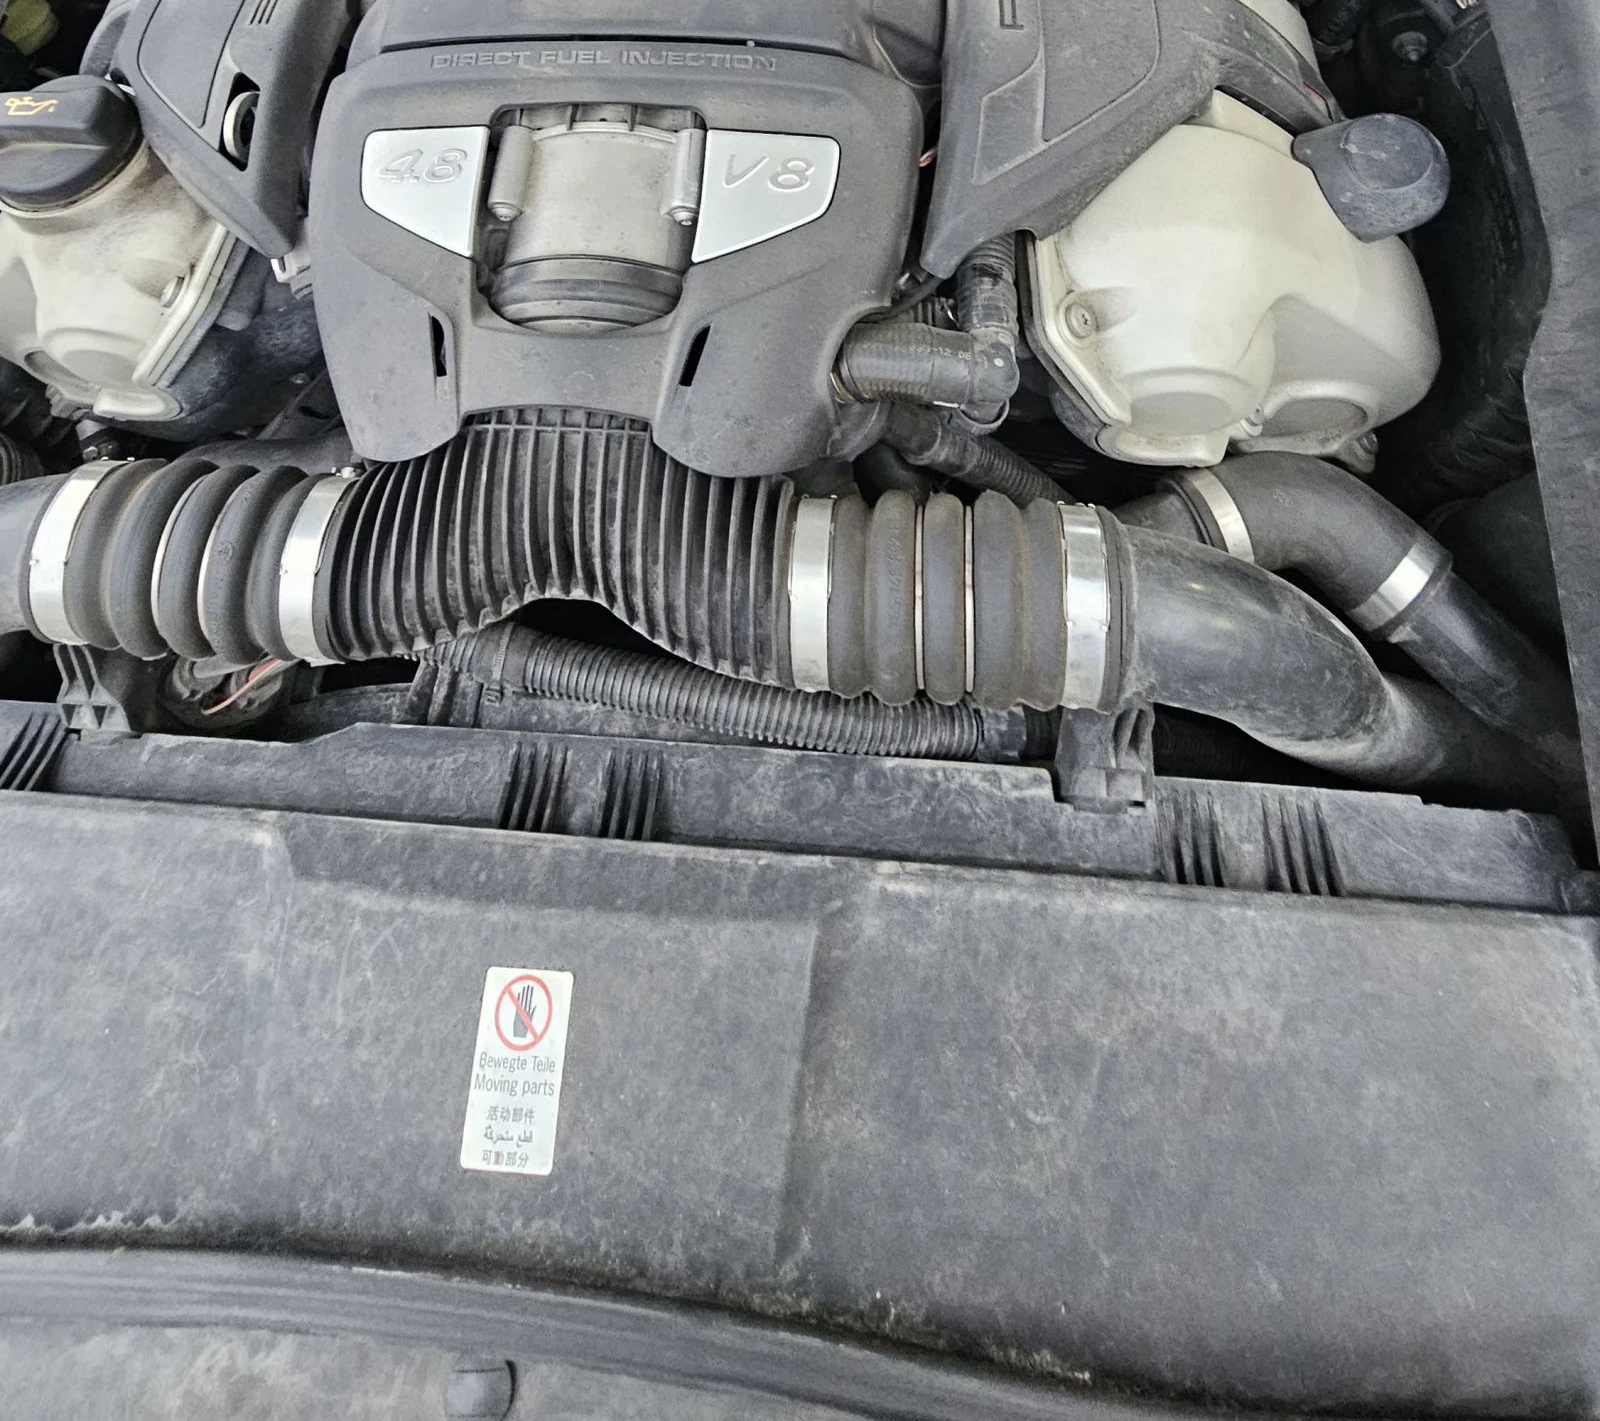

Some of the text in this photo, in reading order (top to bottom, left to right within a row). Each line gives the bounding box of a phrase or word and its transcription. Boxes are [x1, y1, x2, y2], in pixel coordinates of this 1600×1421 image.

[431, 49, 777, 72] DIRECT FUEL INJECTION
[478, 1051, 556, 1074] Bewegte Teile
[474, 1073, 555, 1098] Moving parts
[486, 1105, 536, 1124] 活动部件
[481, 1149, 530, 1168] 可動部分
